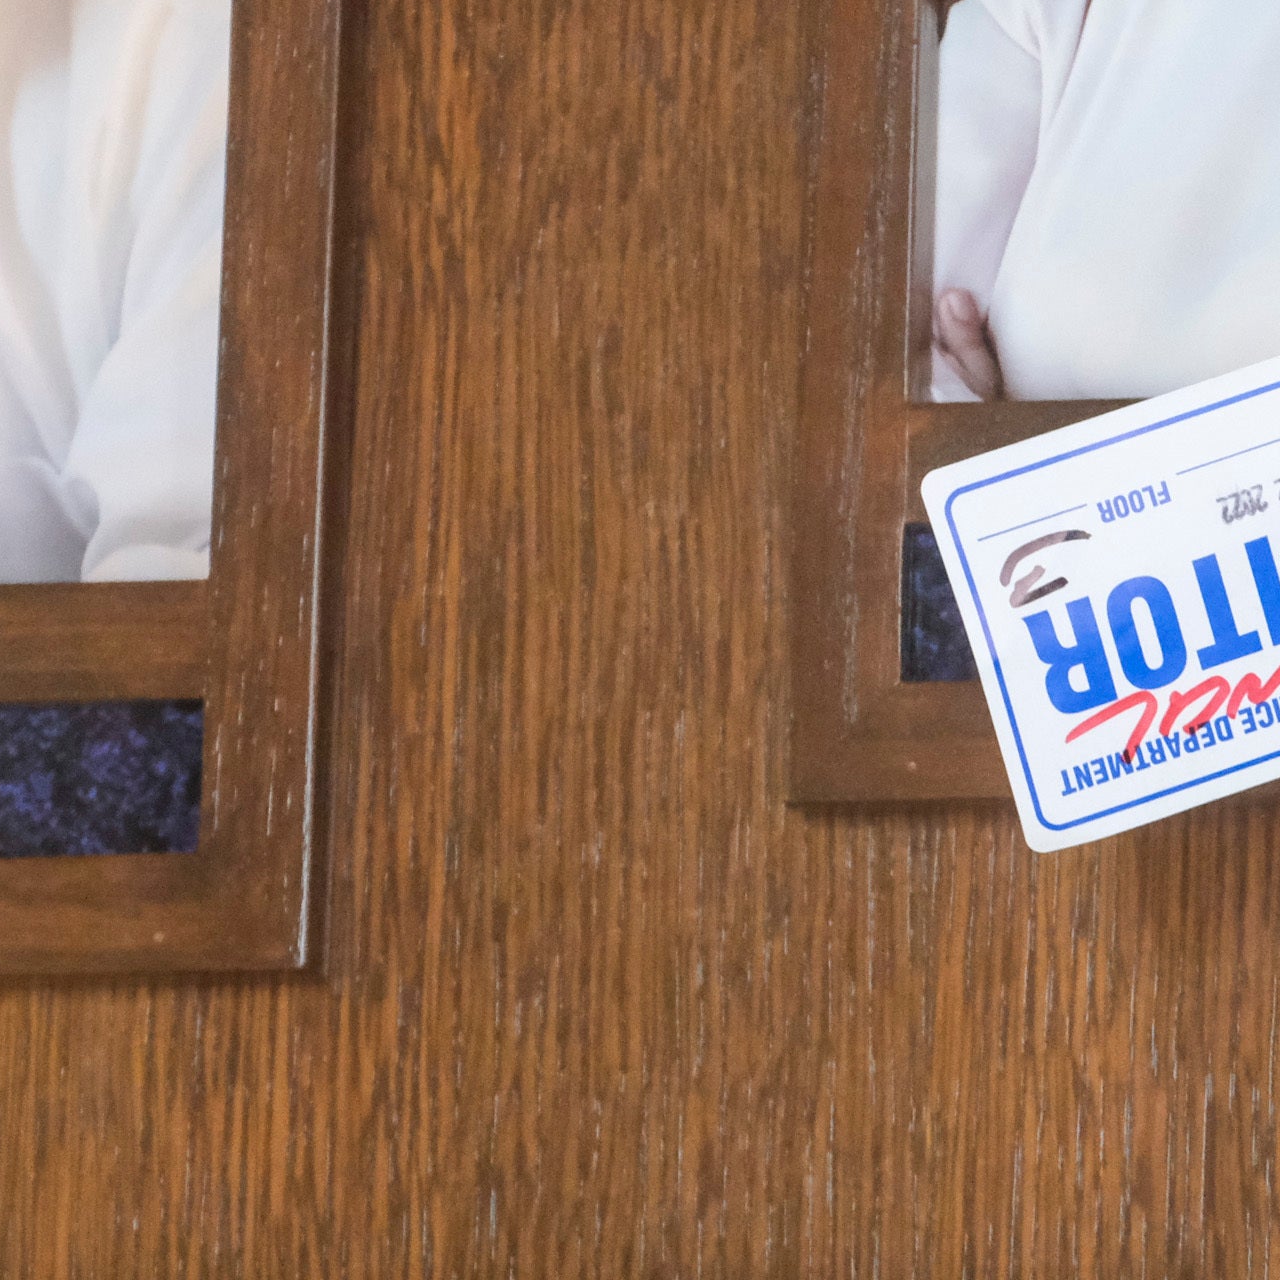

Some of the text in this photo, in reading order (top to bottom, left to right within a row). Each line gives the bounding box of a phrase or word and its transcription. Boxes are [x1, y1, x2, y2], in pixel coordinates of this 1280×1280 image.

[1097, 480, 1173, 524] FLOOR
[1215, 483, 1269, 525] 2022
[999, 529, 1092, 609] 3
[1060, 715, 1234, 797] DEPARTMENT
